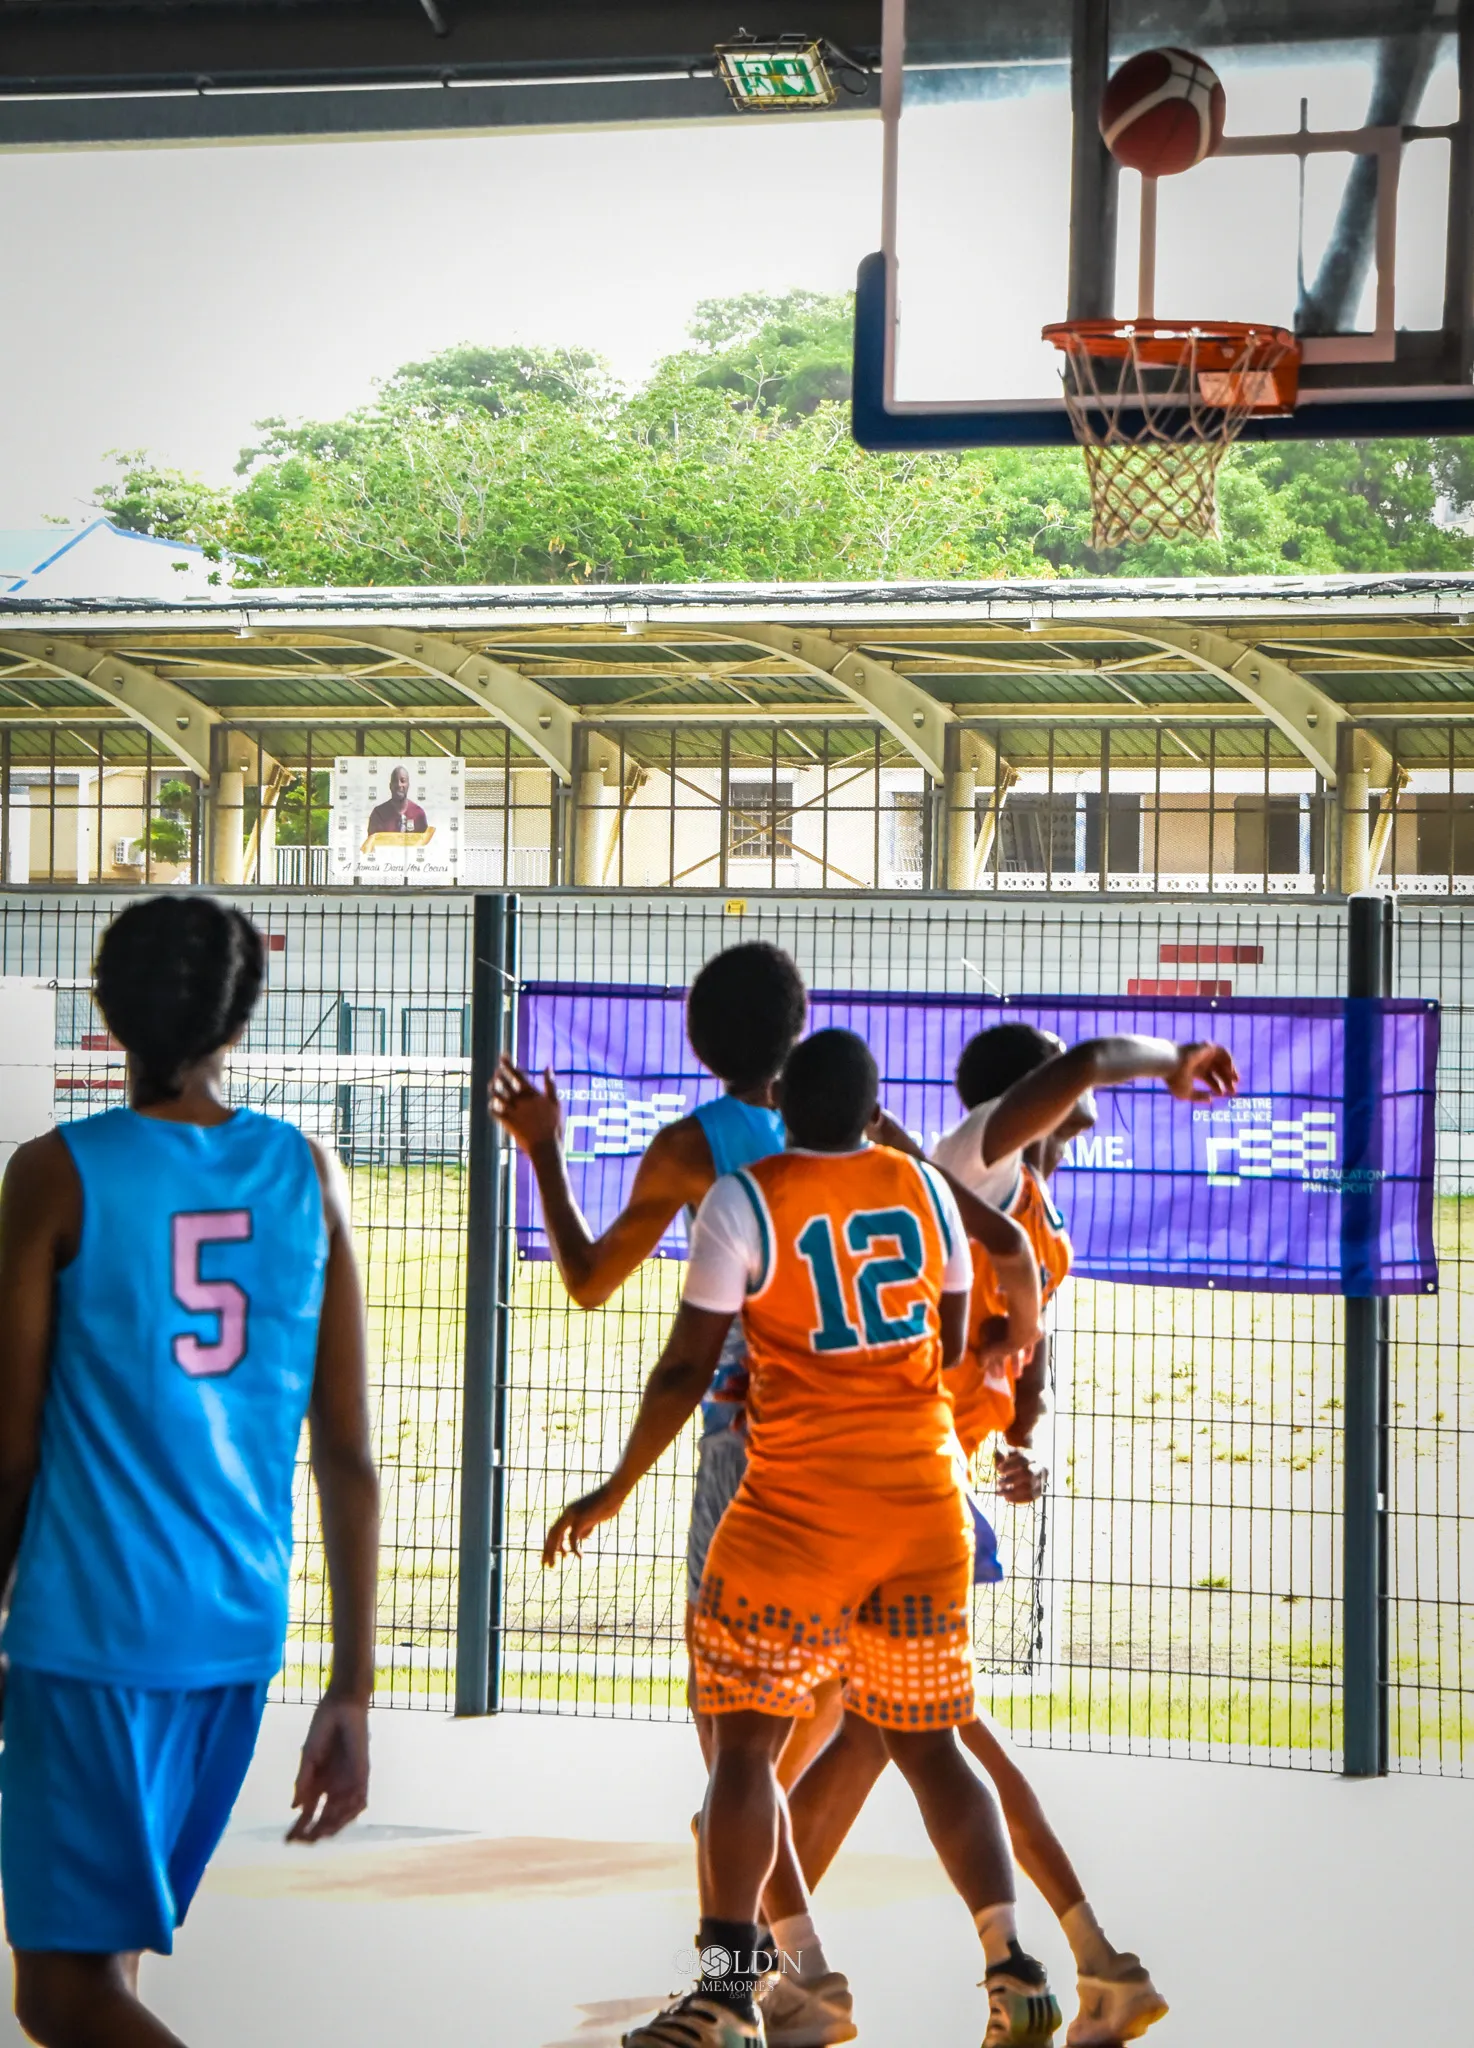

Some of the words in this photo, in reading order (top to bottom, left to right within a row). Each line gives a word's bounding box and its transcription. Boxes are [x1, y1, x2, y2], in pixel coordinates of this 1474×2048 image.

[355, 862, 380, 873] Jamais
[591, 1077, 624, 1089] CENTRE
[1228, 1097, 1272, 1109] CENTRE
[1192, 1109, 1272, 1122] D'EXCELLENCE
[1063, 1135, 1133, 1169] AME.
[794, 1204, 935, 1354] 12
[170, 1207, 253, 1377] 5
